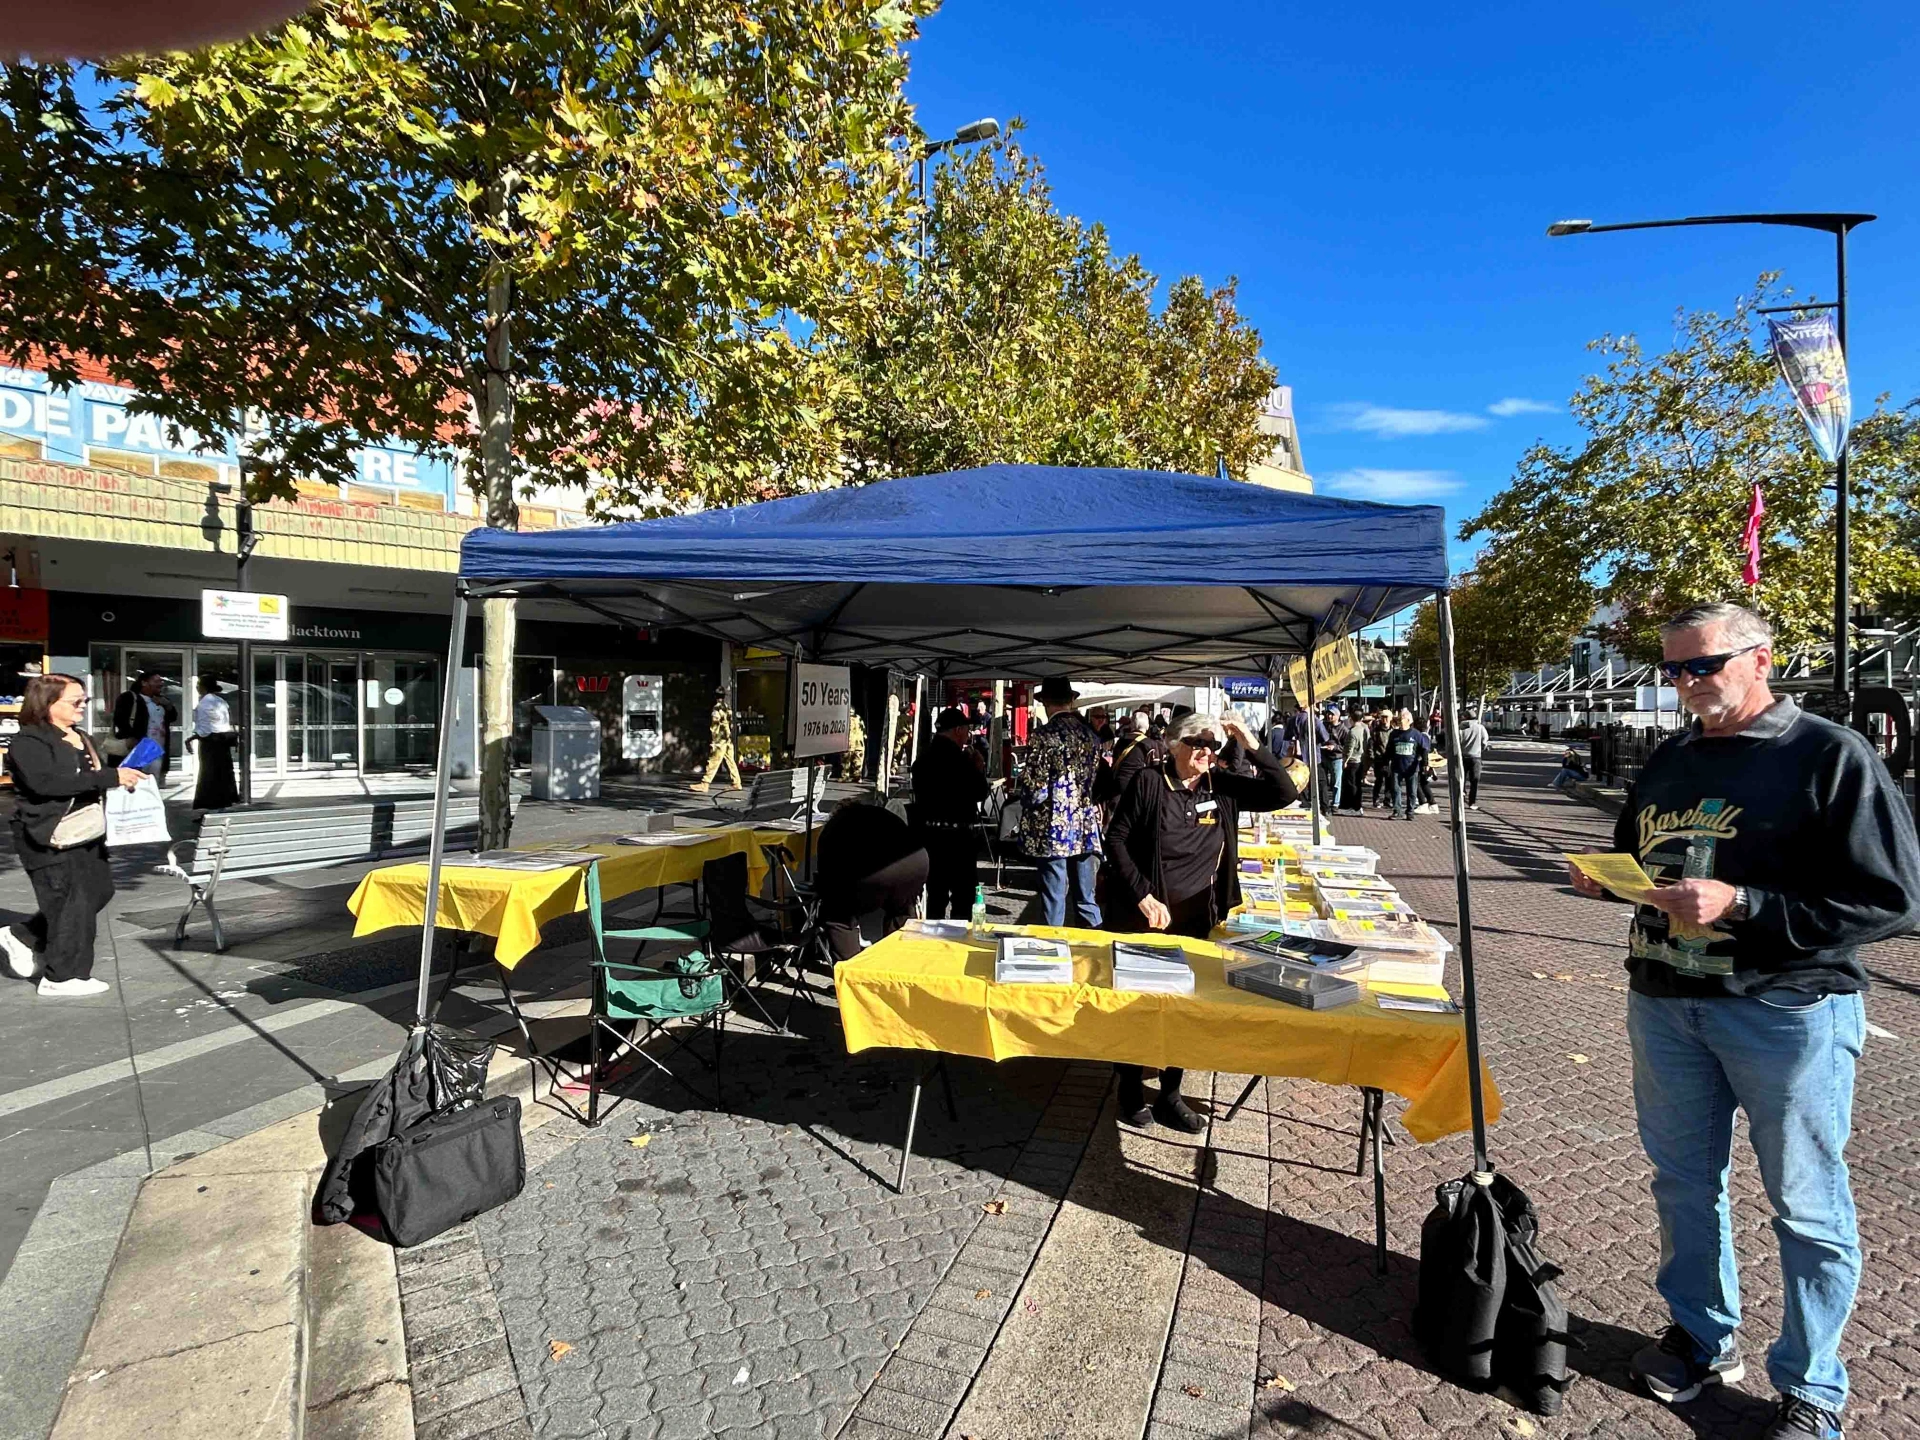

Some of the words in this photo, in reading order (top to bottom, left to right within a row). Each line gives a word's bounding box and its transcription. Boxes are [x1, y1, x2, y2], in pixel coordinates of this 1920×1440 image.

[801, 681, 817, 706] 50
[820, 682, 849, 706] Years
[803, 720, 821, 737] 1976
[821, 722, 829, 735] to
[829, 719, 846, 734] 2026
[1636, 804, 1744, 849] Baseball
